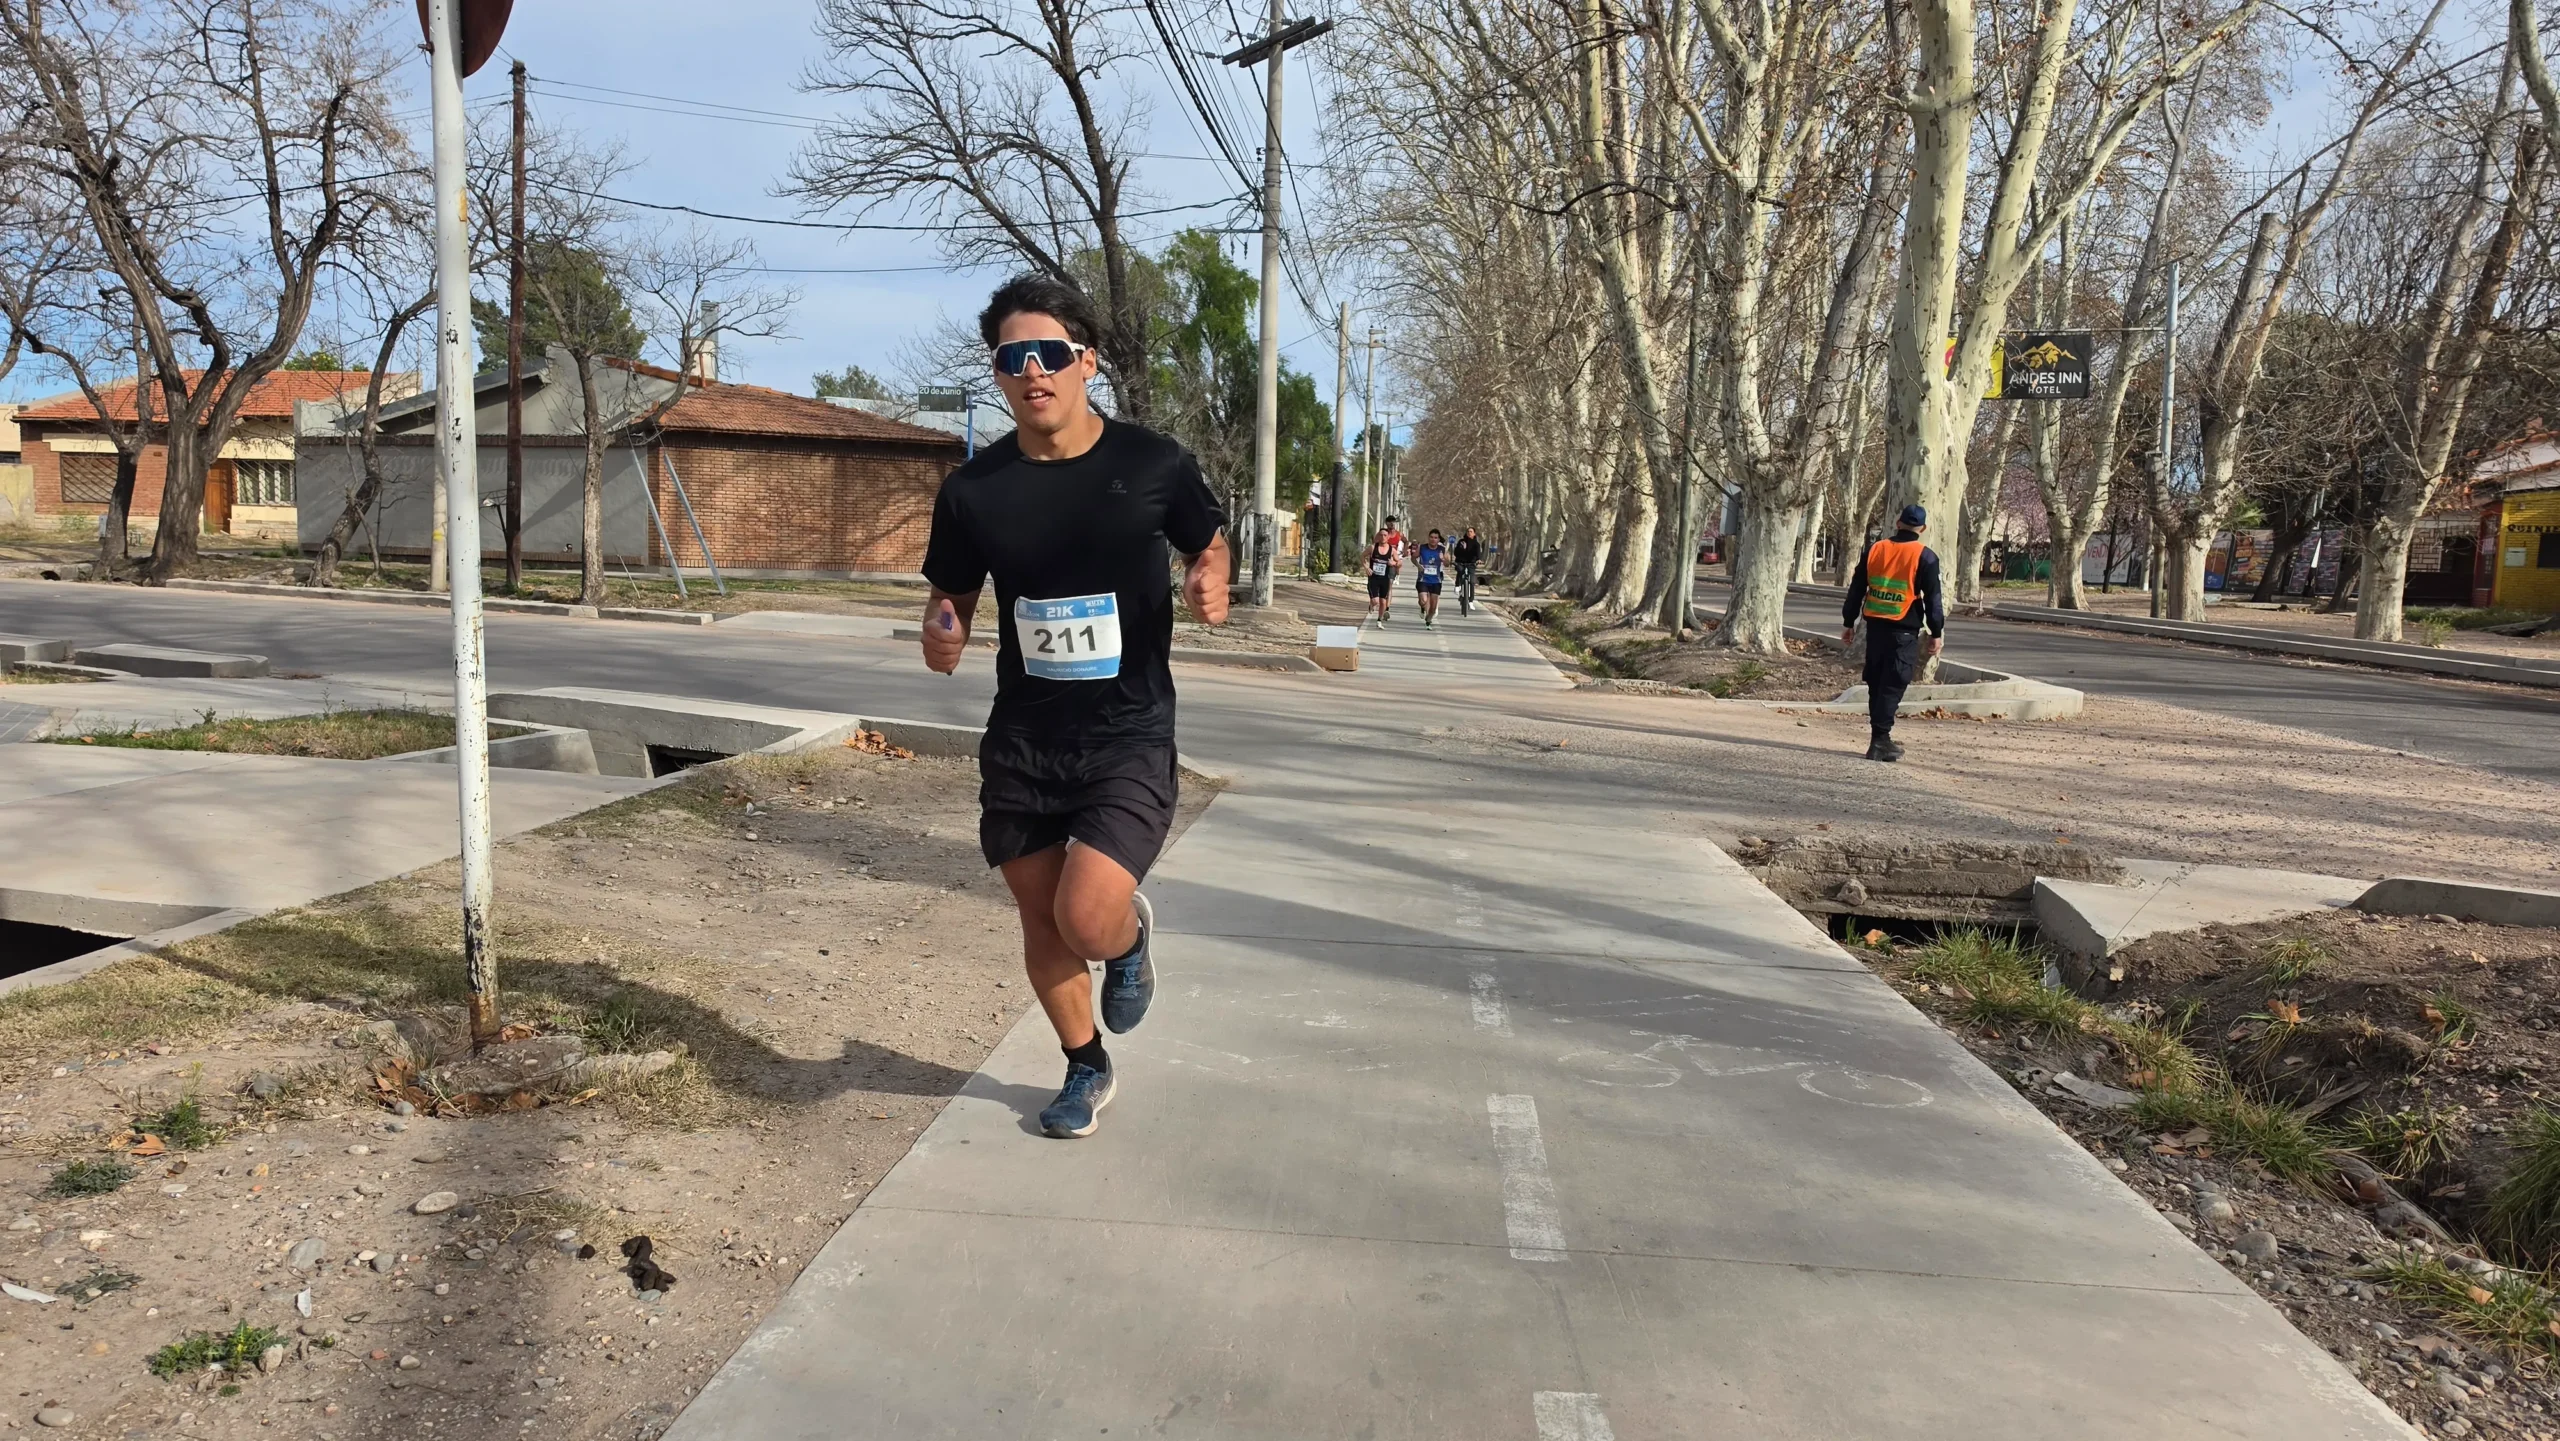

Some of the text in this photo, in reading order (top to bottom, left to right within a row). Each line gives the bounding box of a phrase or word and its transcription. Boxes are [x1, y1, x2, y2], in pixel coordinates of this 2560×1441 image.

[2009, 371, 2082, 384] ANDES INN
[919, 386, 961, 395] 20 de Junio
[2028, 386, 2061, 394] HOTEL
[1046, 605, 1075, 618] 21K
[1034, 625, 1096, 654] 211
